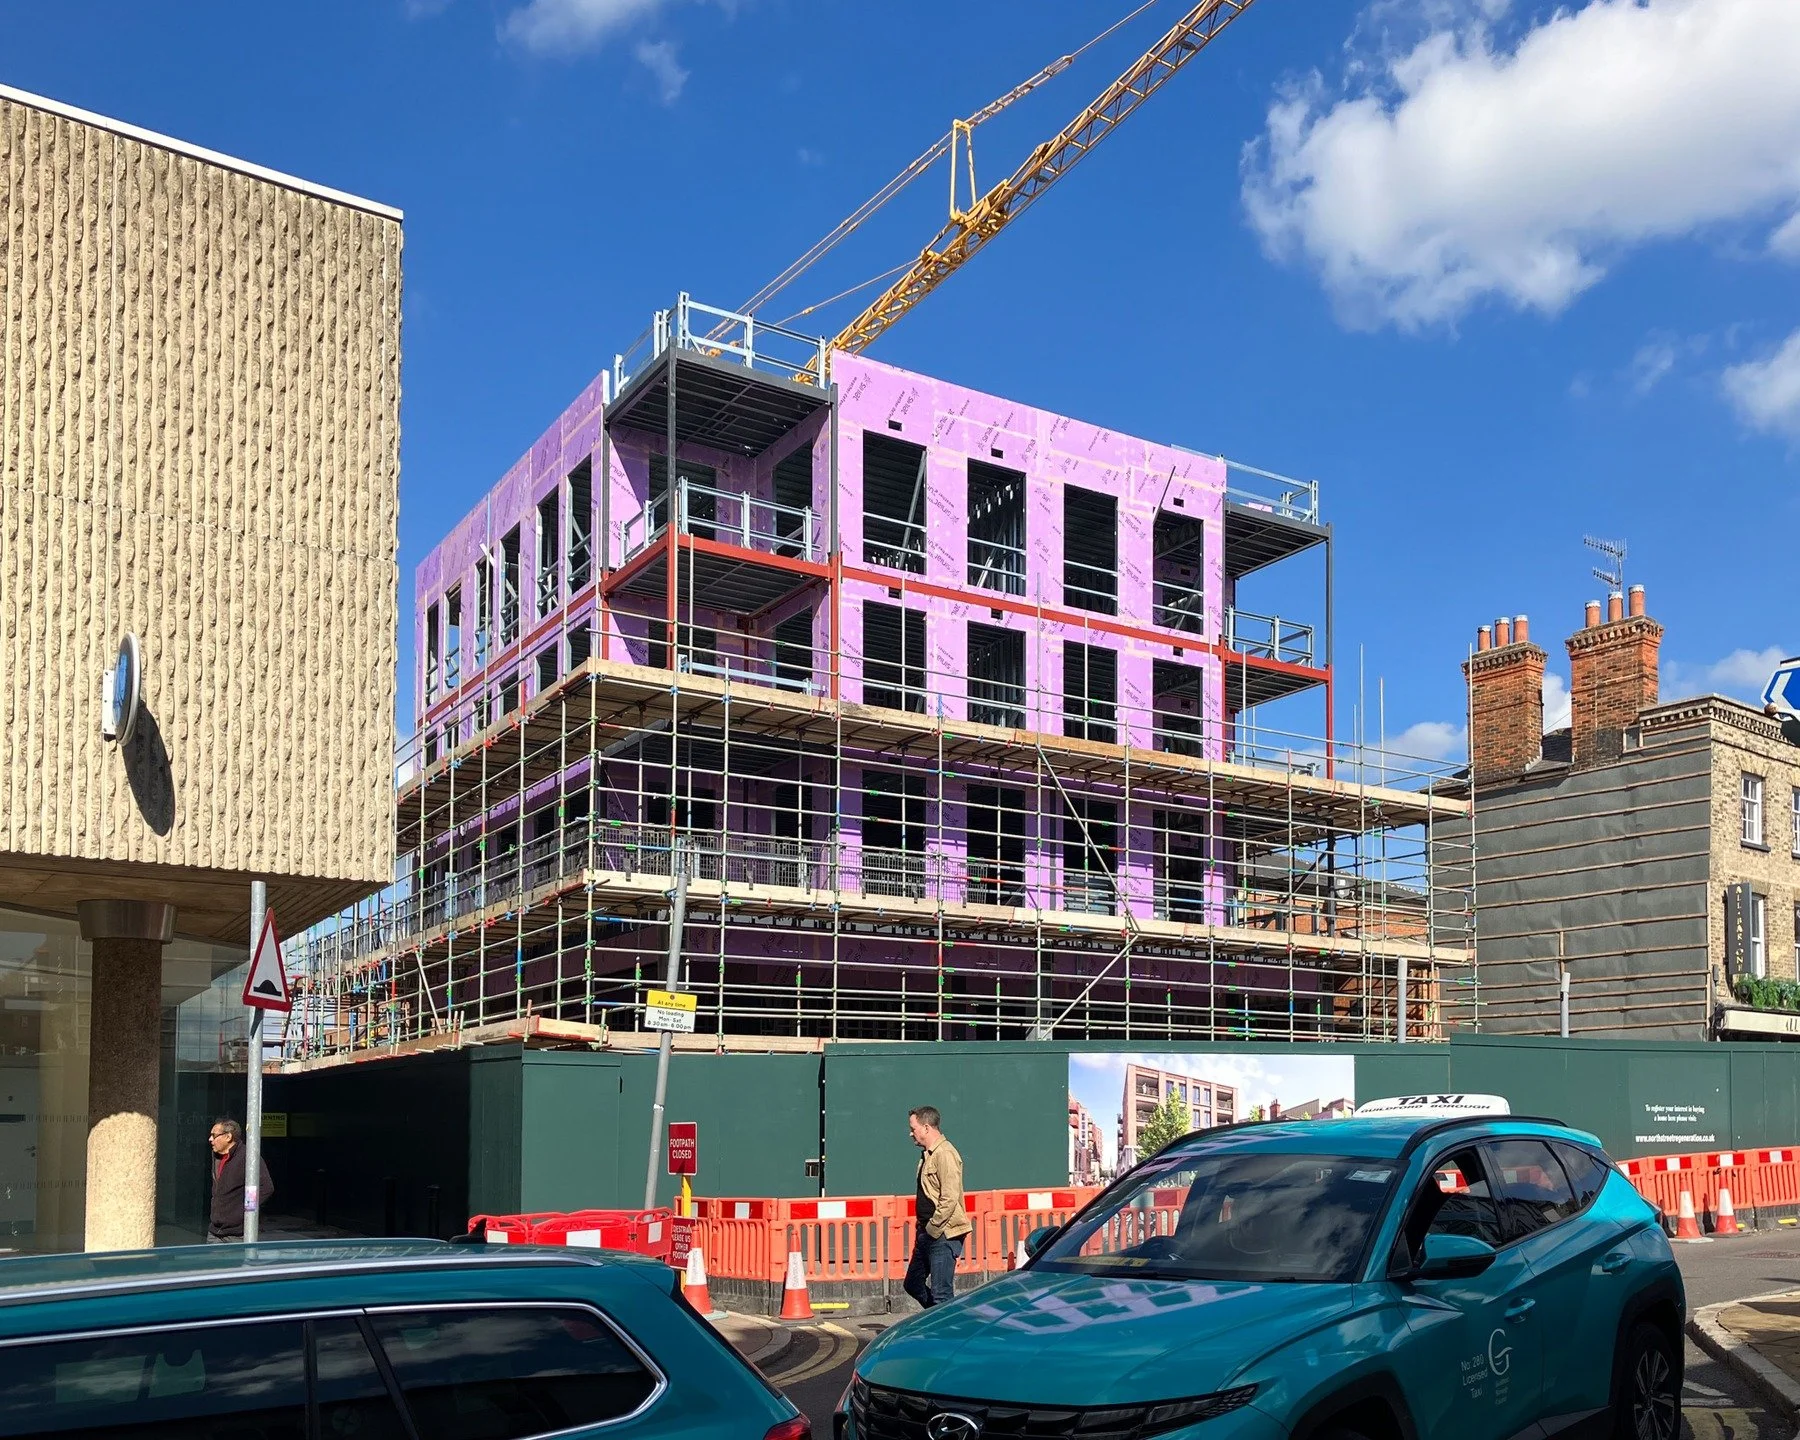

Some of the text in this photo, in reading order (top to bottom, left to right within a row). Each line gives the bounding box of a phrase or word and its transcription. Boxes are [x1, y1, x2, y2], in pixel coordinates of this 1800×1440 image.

[666, 1010, 684, 1018] loading
[1398, 1095, 1465, 1105] TAXI
[1360, 1105, 1423, 1113] GUILDFORD
[670, 1138, 695, 1148] FOOTPATH
[672, 1149, 692, 1159] CLOSED
